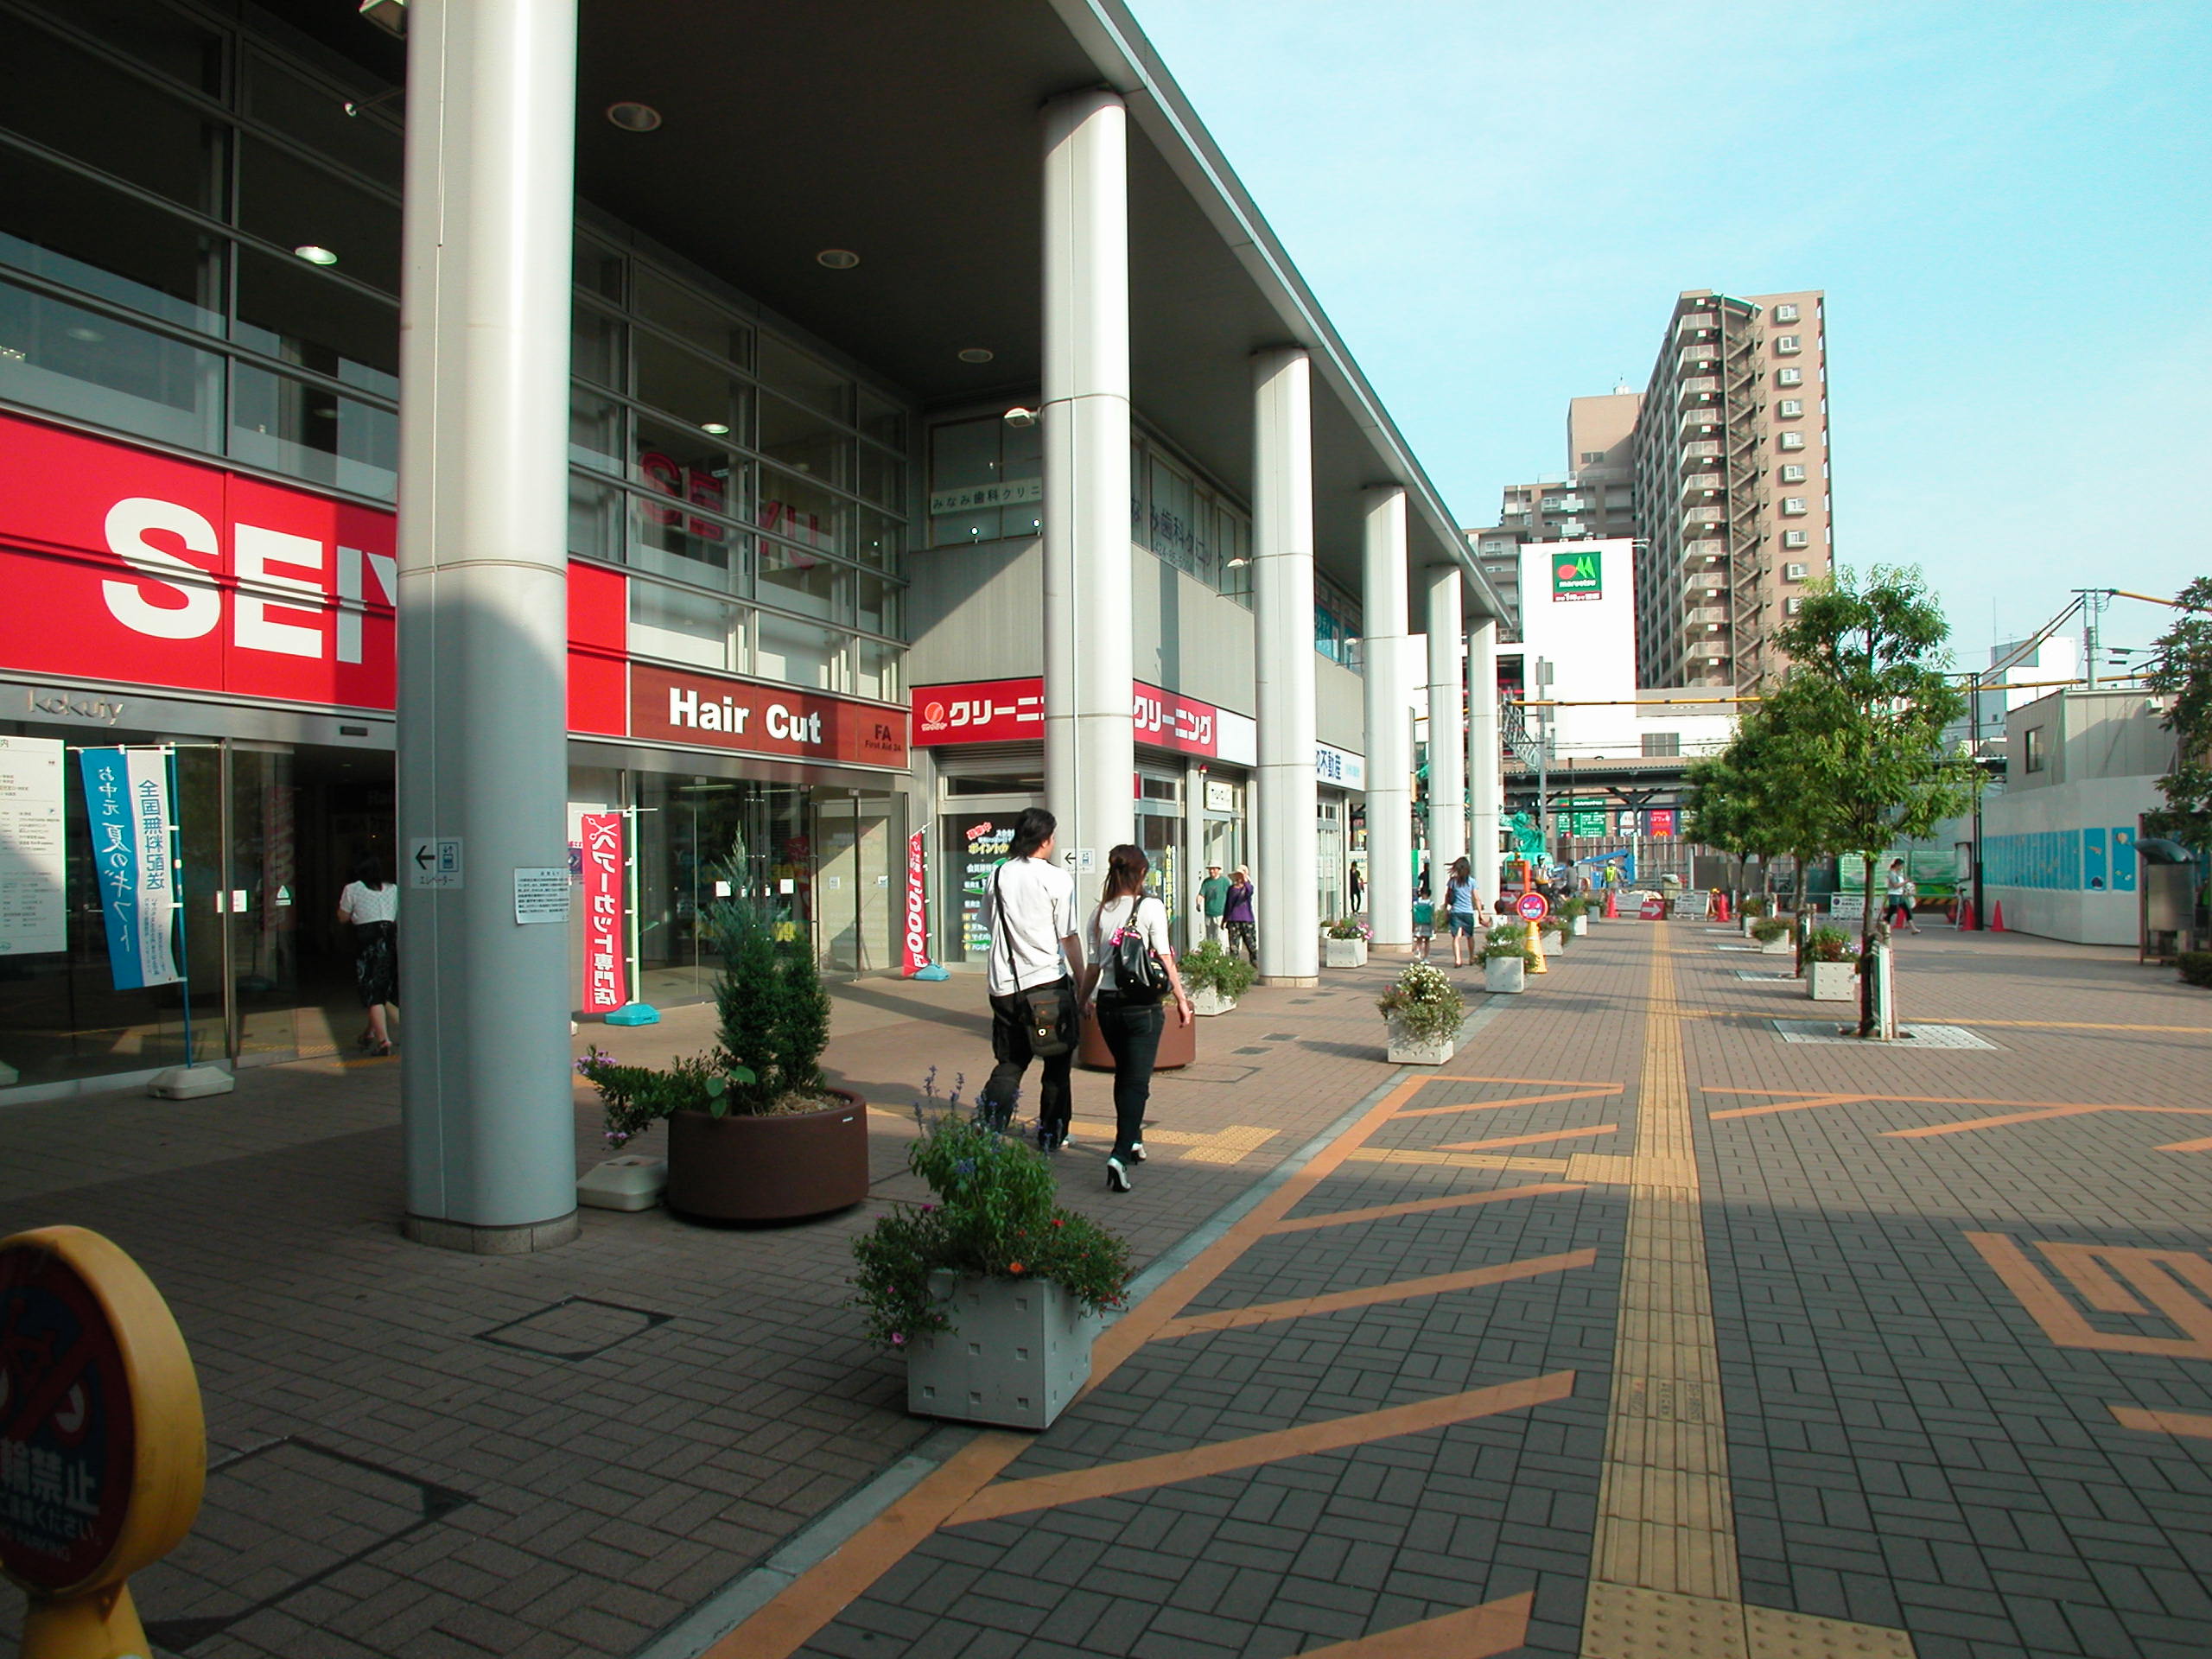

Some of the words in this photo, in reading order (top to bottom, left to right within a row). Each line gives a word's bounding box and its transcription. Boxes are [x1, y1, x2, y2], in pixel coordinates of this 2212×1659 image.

[642, 452, 817, 570] SEYU
[669, 687, 750, 734] Hair
[766, 703, 823, 744] Cut
[874, 723, 892, 741] FA
[949, 696, 1045, 727] クリーニ
[1133, 695, 1212, 745] クリーニング
